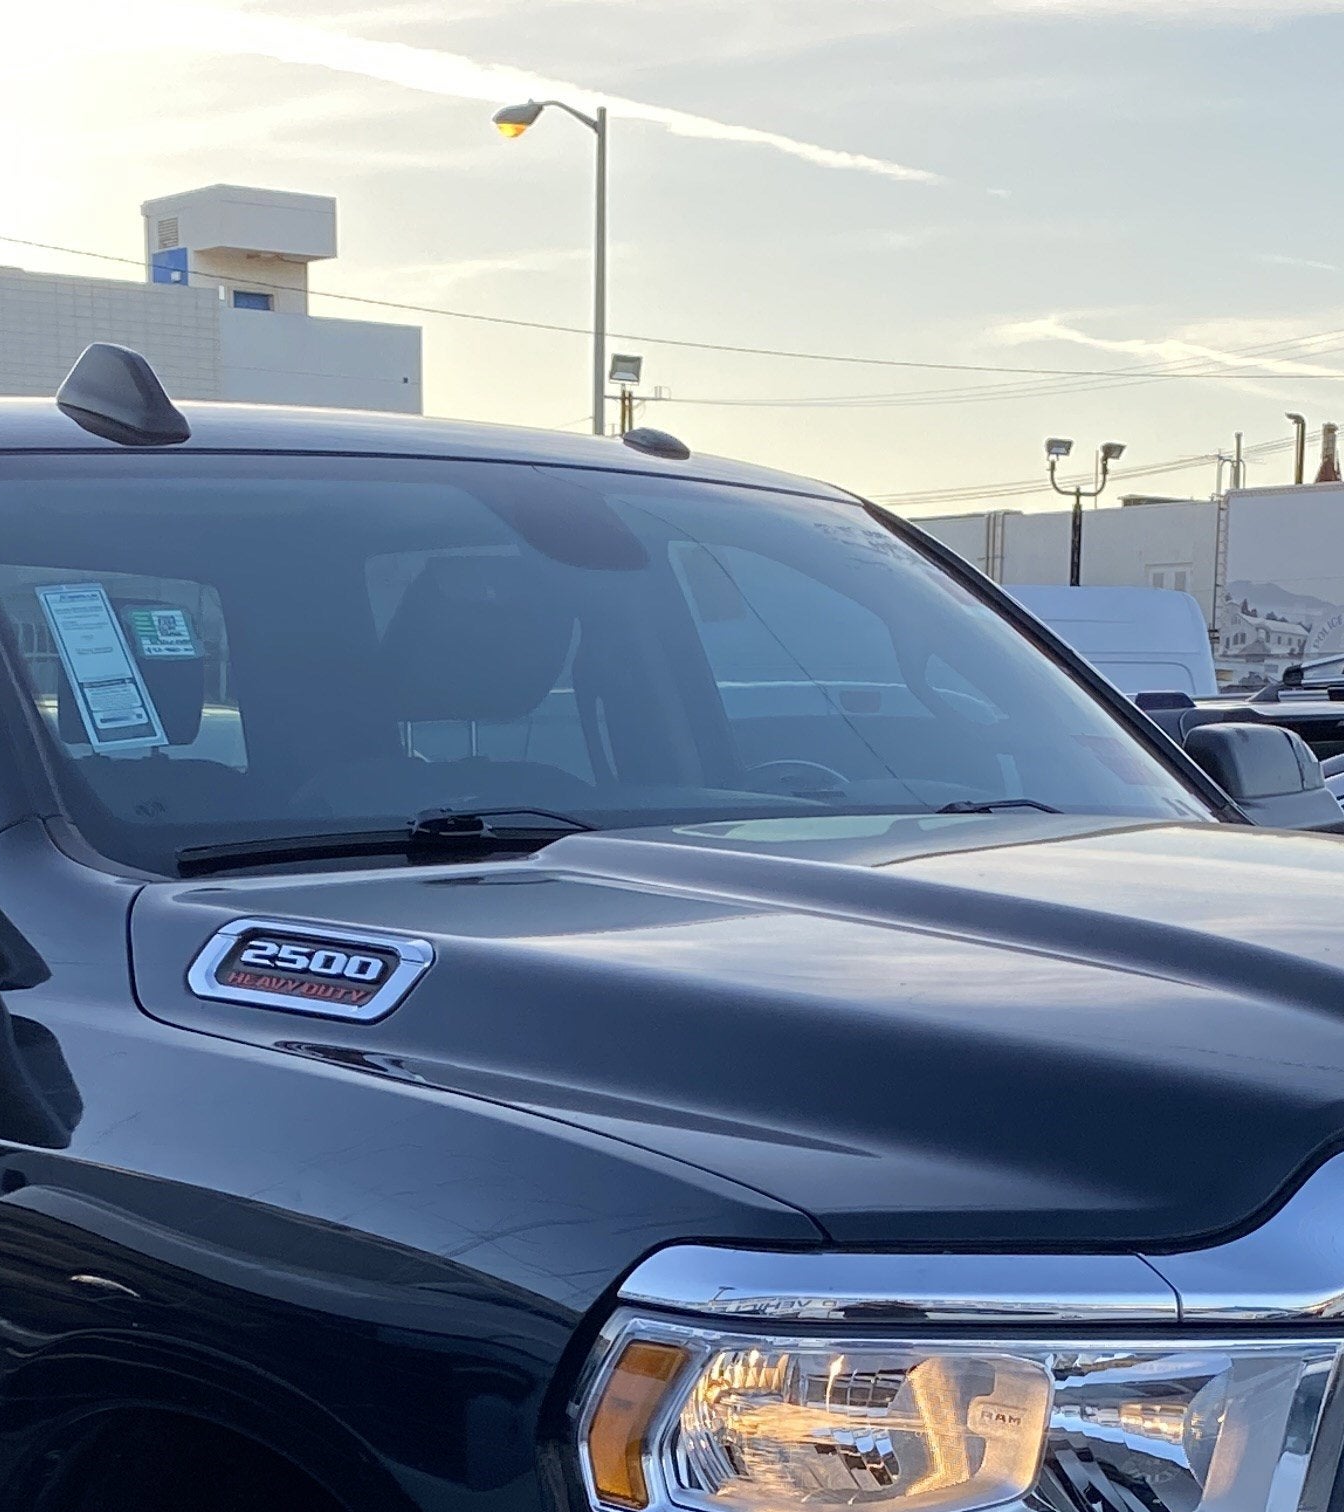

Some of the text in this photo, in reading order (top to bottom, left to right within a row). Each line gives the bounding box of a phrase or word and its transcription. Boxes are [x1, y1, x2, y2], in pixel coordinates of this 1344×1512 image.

[1312, 614, 1343, 649] POLICE
[240, 940, 385, 981] 2500
[227, 972, 371, 1003] HEAVY DUTY
[980, 1410, 1022, 1426] RAM
